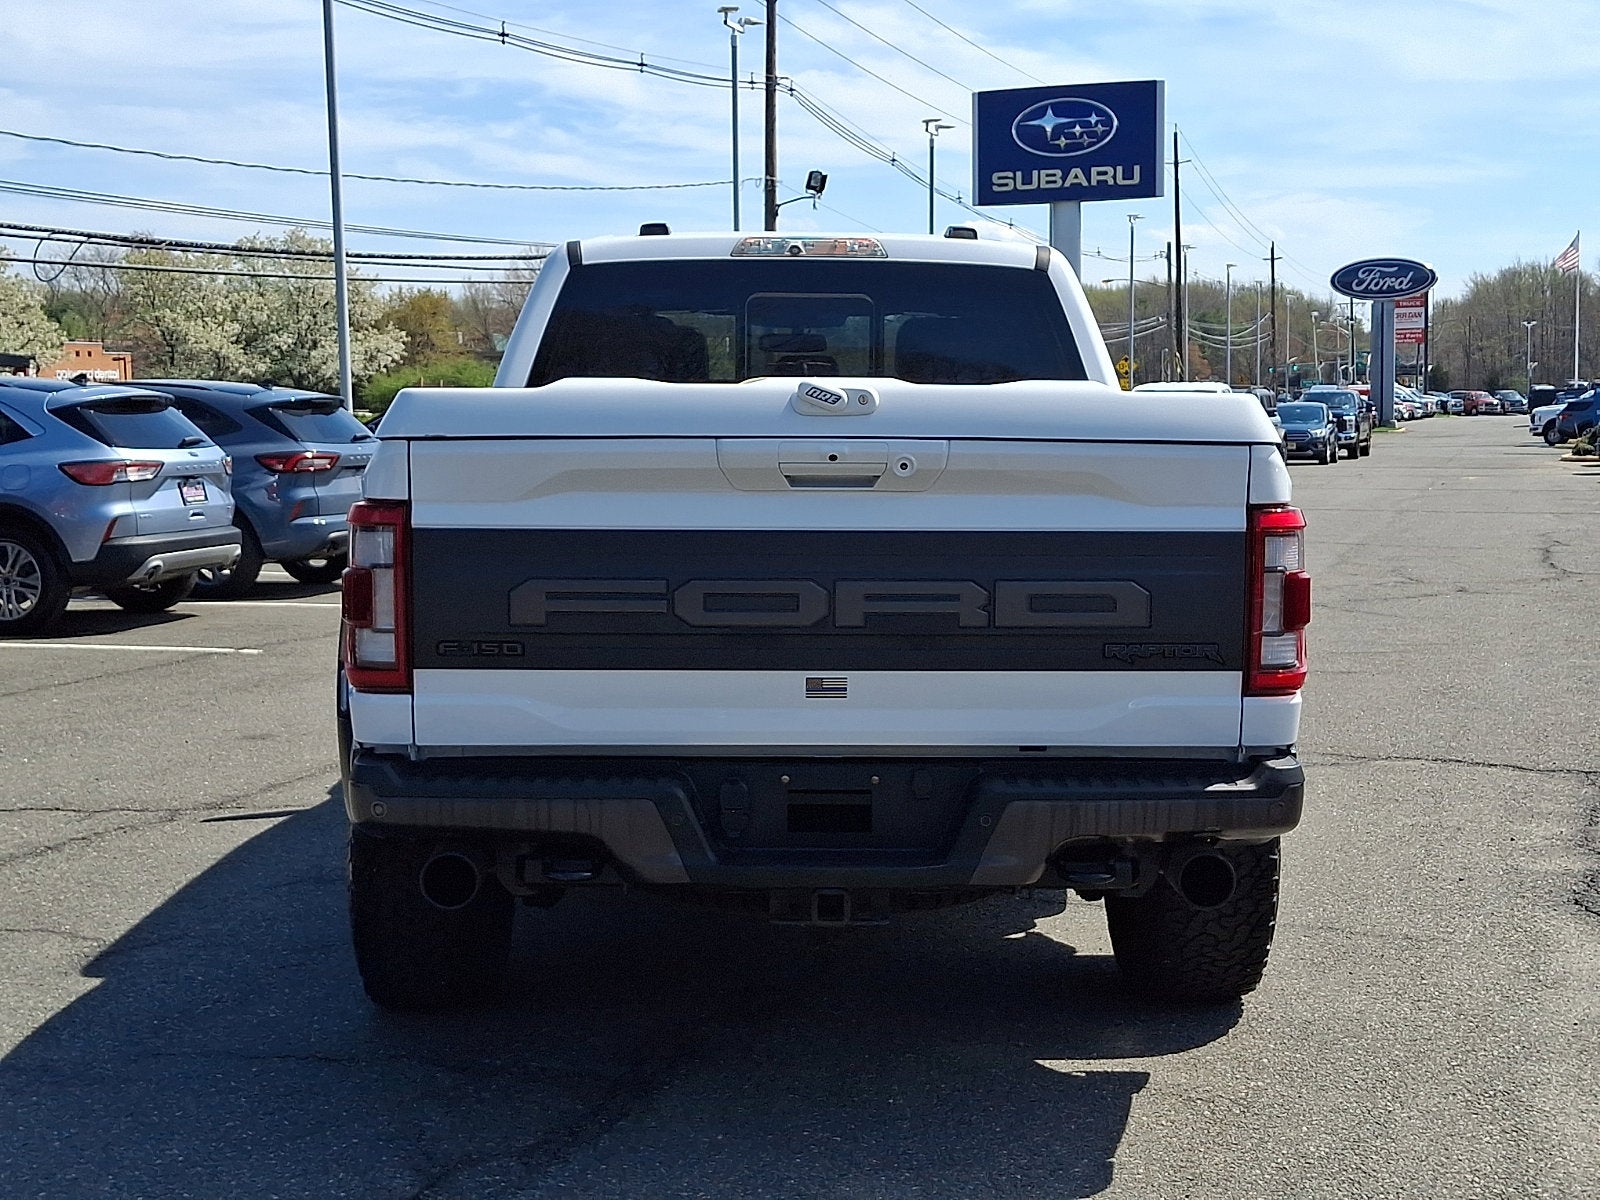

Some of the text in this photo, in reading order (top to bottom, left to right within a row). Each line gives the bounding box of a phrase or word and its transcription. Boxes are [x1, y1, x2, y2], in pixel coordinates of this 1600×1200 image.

[991, 165, 1141, 192] SUBARU
[1351, 266, 1414, 291] Ford
[508, 578, 1152, 628] FORD
[436, 640, 526, 657] F-150
[1104, 642, 1225, 665] RAPTOR
